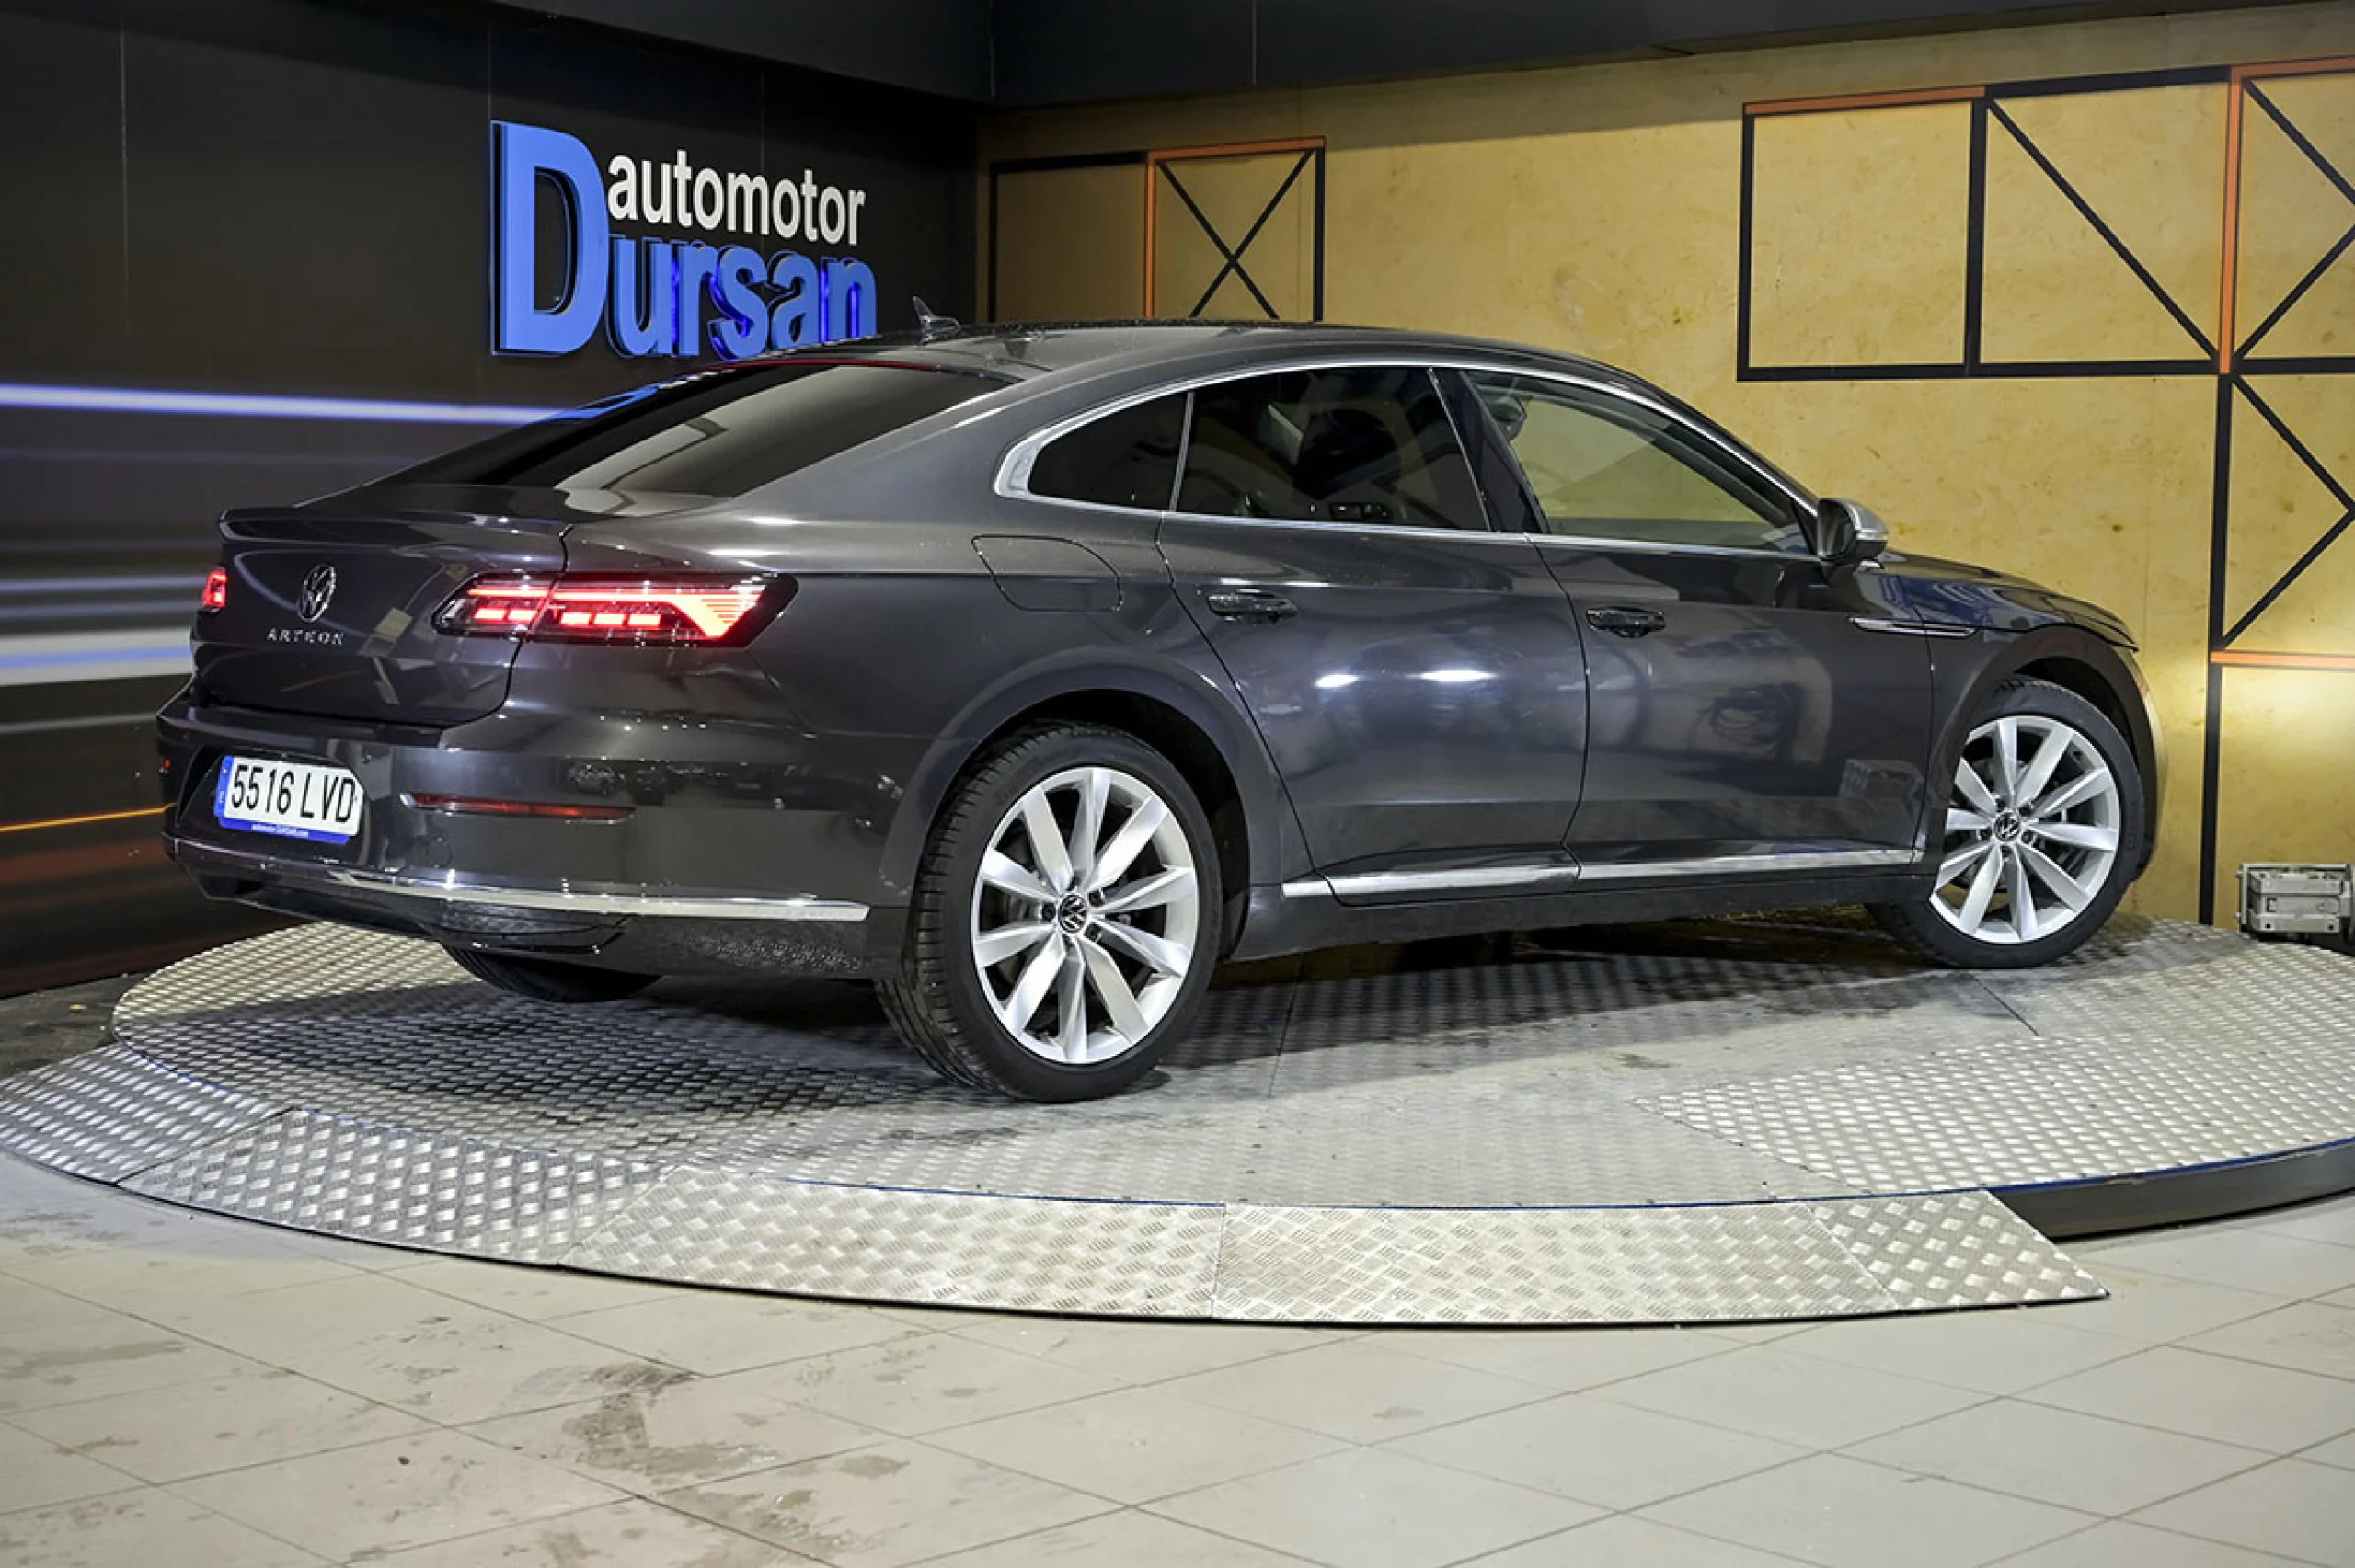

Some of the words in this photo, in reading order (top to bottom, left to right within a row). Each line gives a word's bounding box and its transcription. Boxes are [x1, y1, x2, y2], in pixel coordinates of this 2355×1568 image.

[608, 148, 867, 246] automotor
[490, 119, 878, 361] Dursan
[266, 627, 344, 646] ARTEON
[231, 764, 295, 815] 5516
[299, 773, 356, 823] LVD
